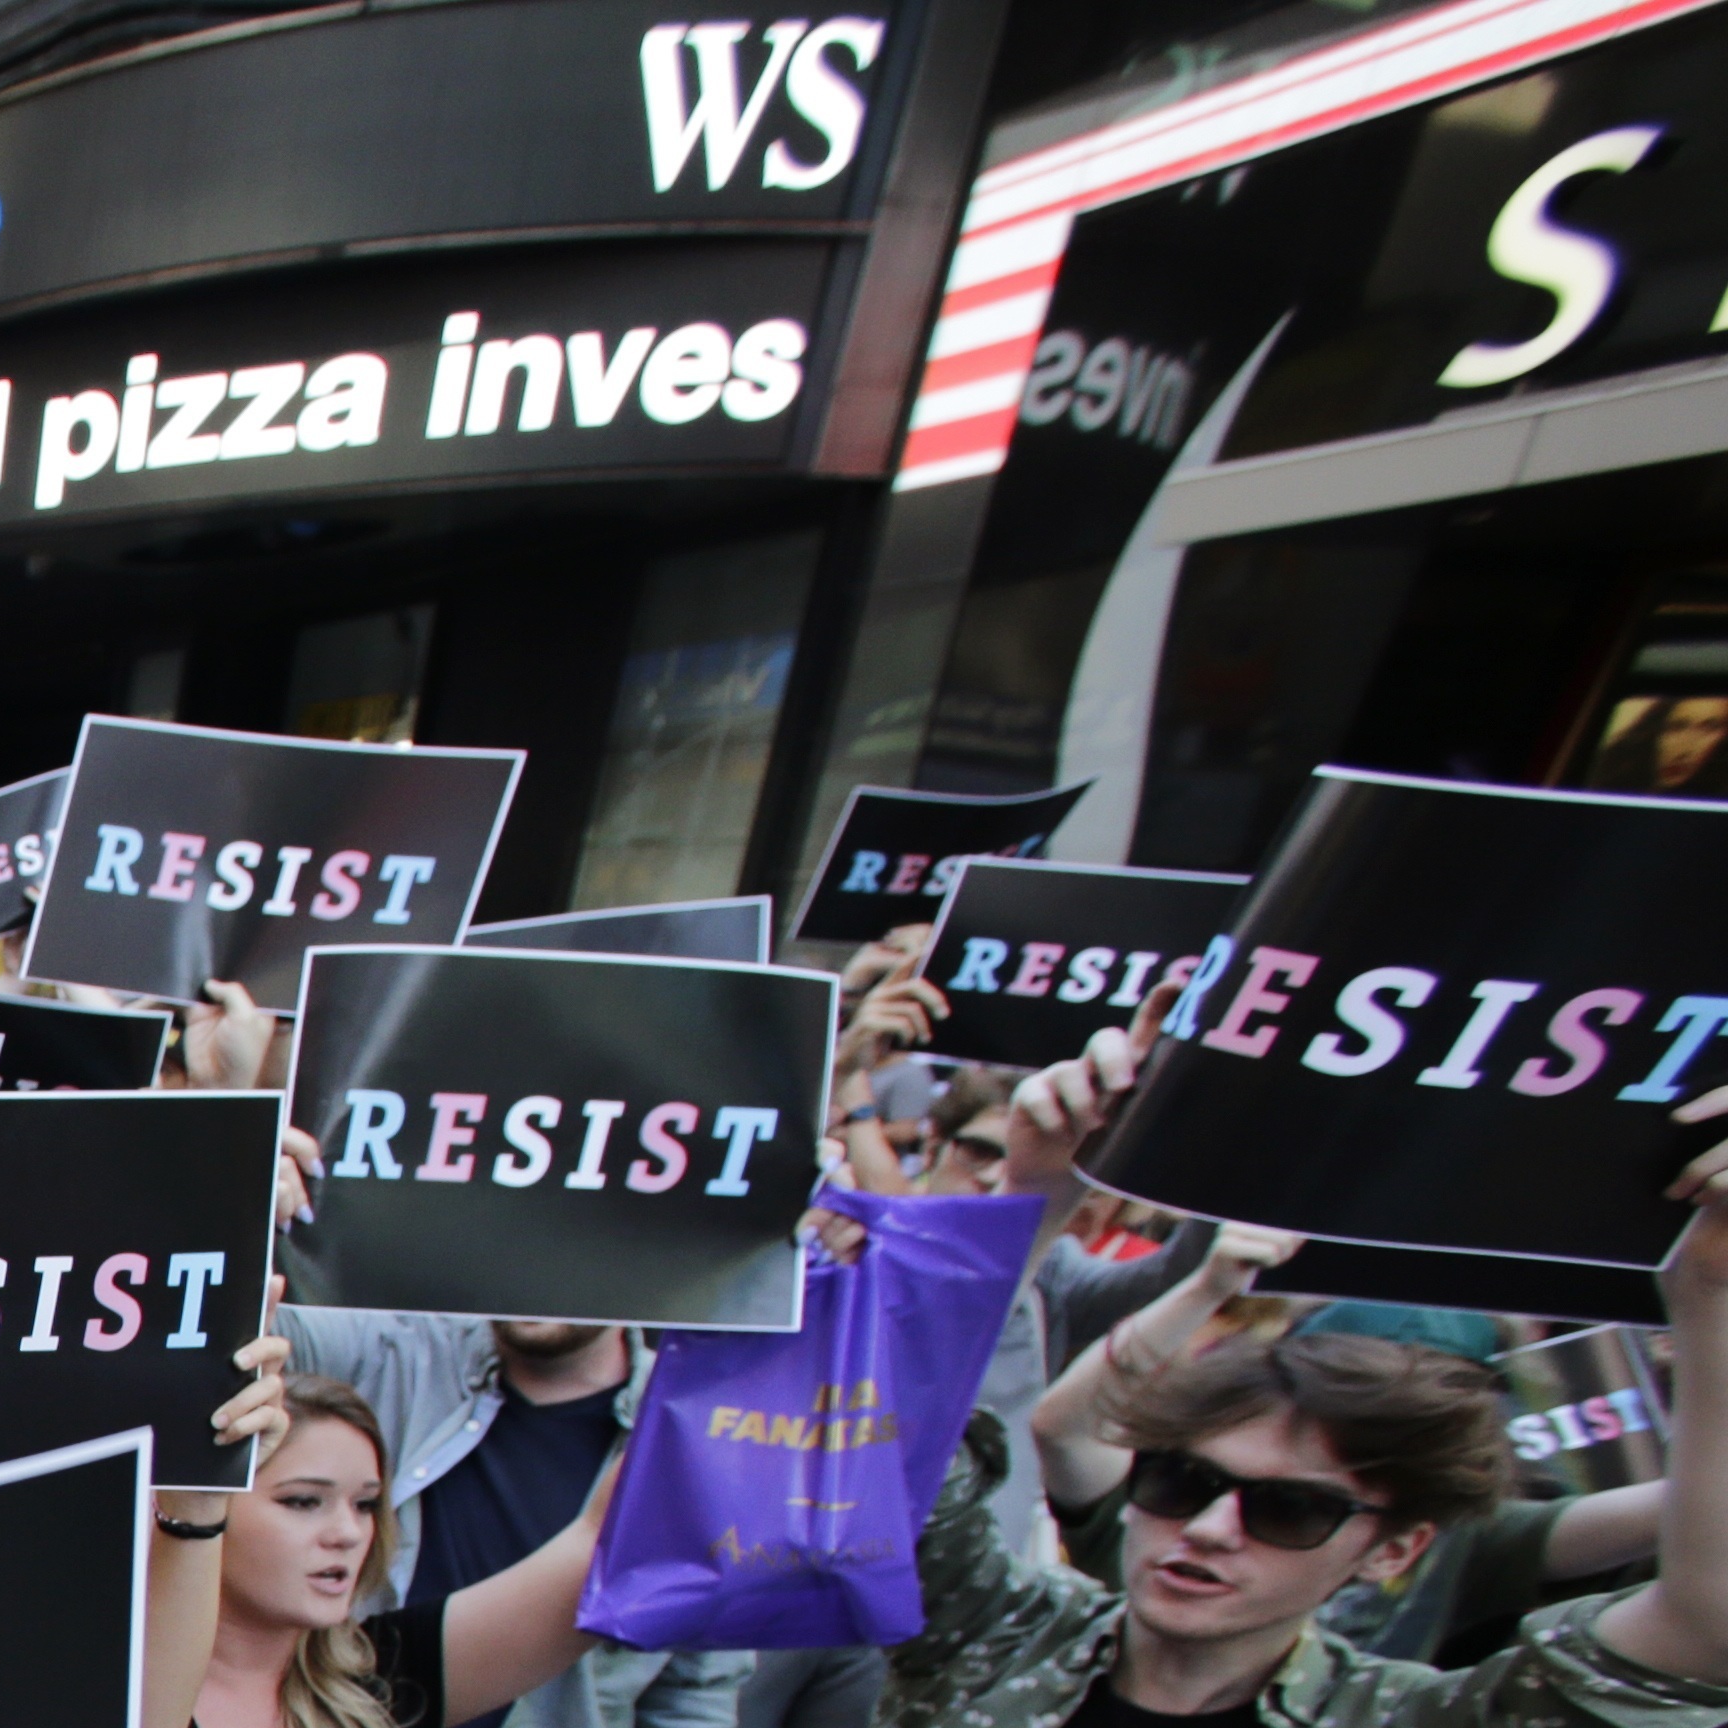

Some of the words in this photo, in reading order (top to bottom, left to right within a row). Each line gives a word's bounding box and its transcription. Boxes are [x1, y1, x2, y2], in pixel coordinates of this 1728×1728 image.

[639, 16, 885, 192] WS
[34, 353, 389, 510] pizza
[424, 311, 807, 439] inves
[84, 824, 436, 925] RESIST
[1159, 934, 1728, 1103] RESIST
[332, 1089, 778, 1197] RESIST
